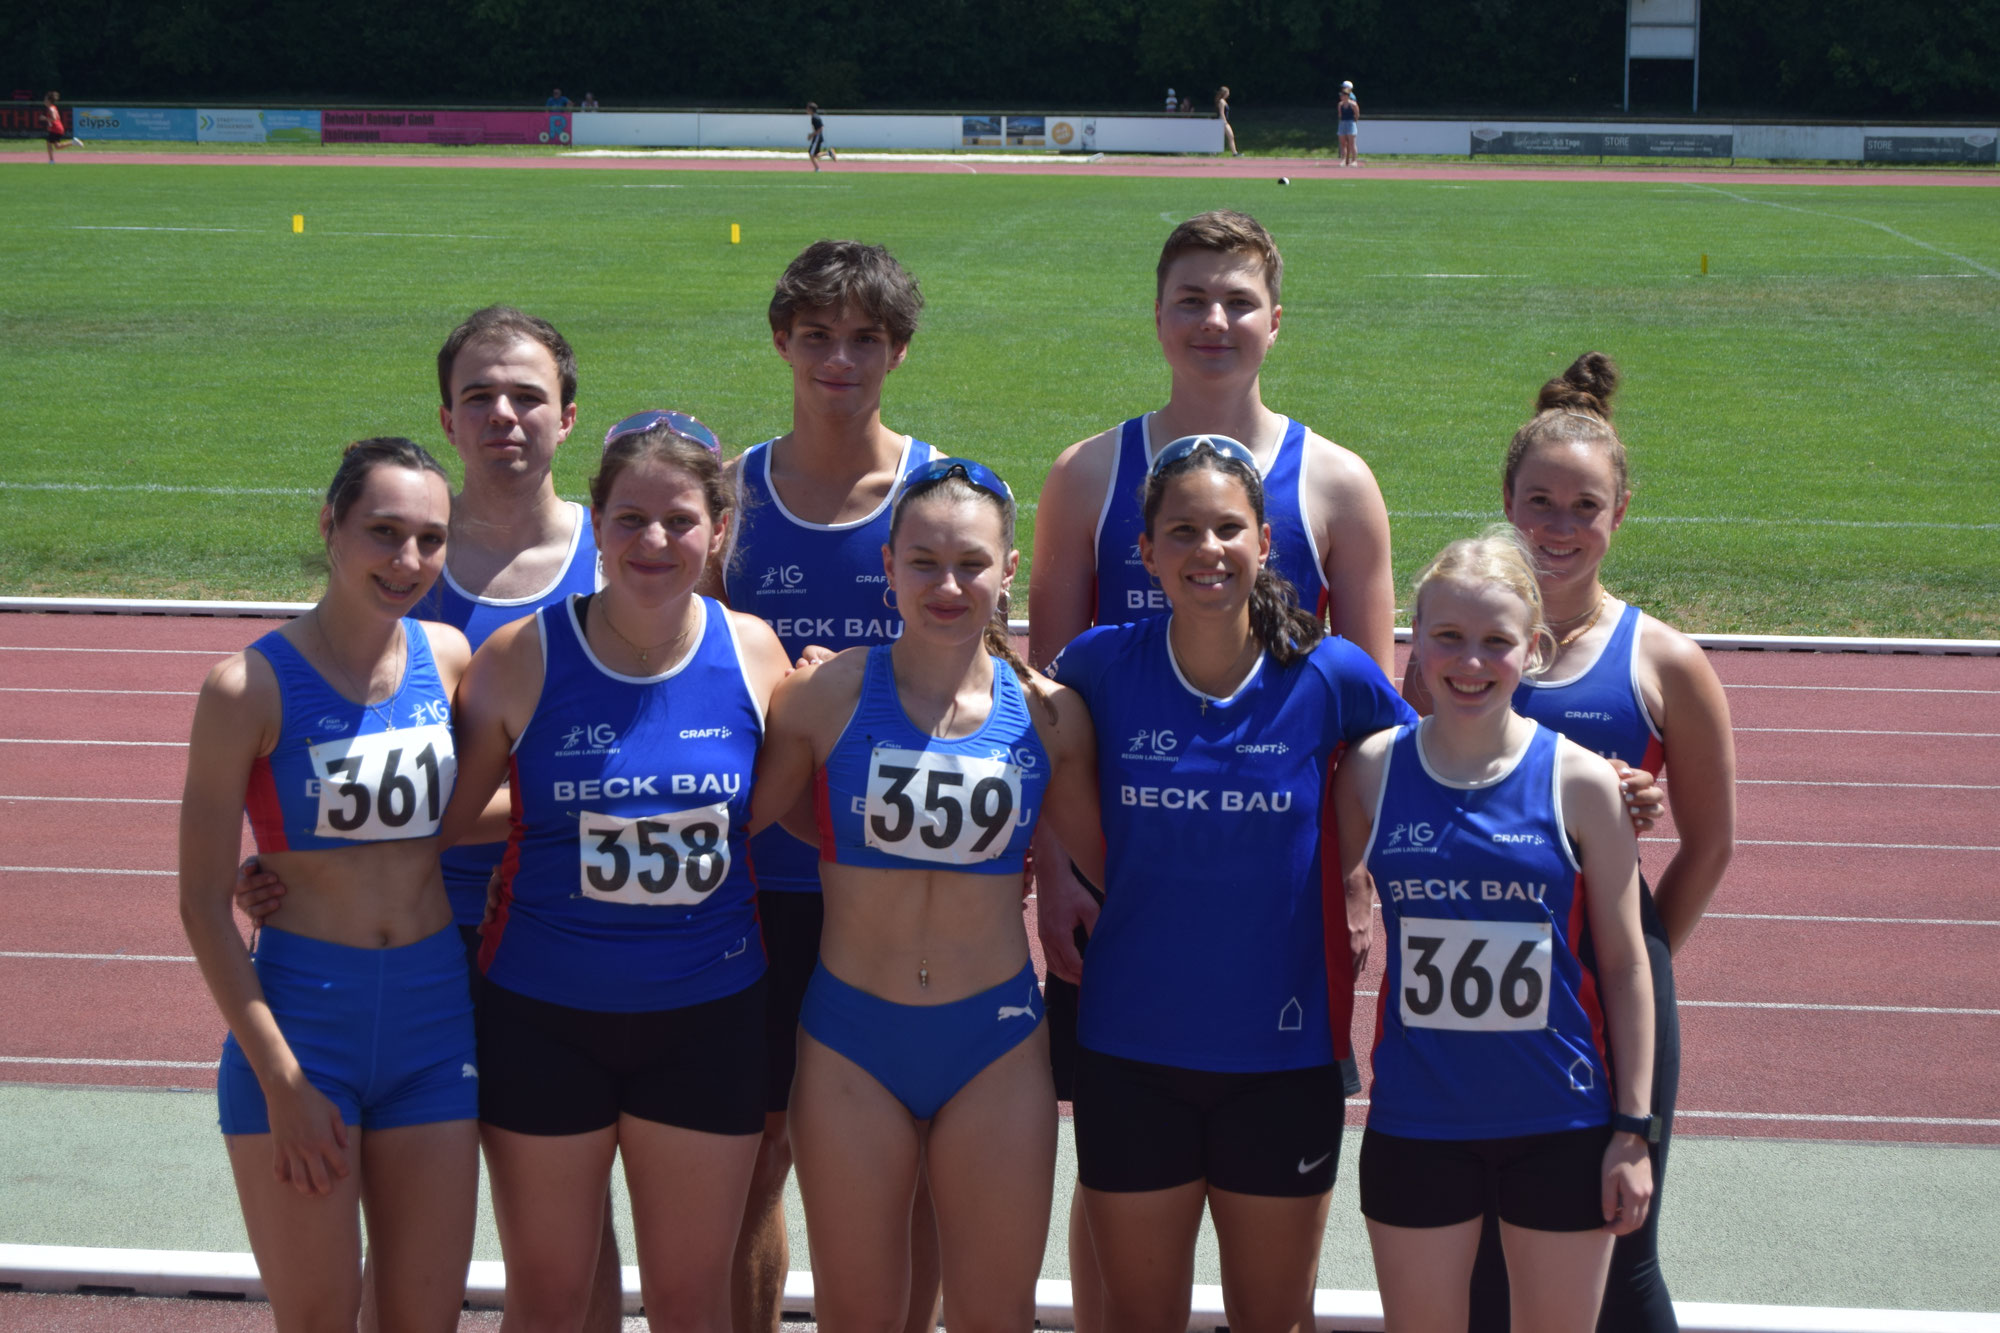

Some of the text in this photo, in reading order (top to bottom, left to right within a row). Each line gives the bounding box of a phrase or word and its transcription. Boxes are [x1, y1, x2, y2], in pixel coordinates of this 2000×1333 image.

[79, 117, 120, 130] elypso
[408, 113, 434, 126] GmbH
[1604, 136, 1630, 146] STORE
[1867, 140, 1893, 150] STORE
[1127, 589, 1173, 609] BE
[766, 617, 904, 639] ECK BAU
[1564, 711, 1602, 720] CRAFT
[679, 727, 721, 739] CRAFT
[554, 748, 621, 757] REGION LANDSHUT
[1235, 743, 1278, 755] CRAFT
[1121, 753, 1179, 762] REGION LANDSHUT
[326, 741, 440, 831] 361
[553, 773, 741, 802] BECK BAU
[1121, 785, 1292, 813] BECK BAU
[870, 764, 1013, 853] 359
[1492, 834, 1534, 844] CRAFT
[586, 821, 725, 894] 358
[1388, 879, 1548, 903] BECK BAU
[1405, 935, 1543, 1019] 366
